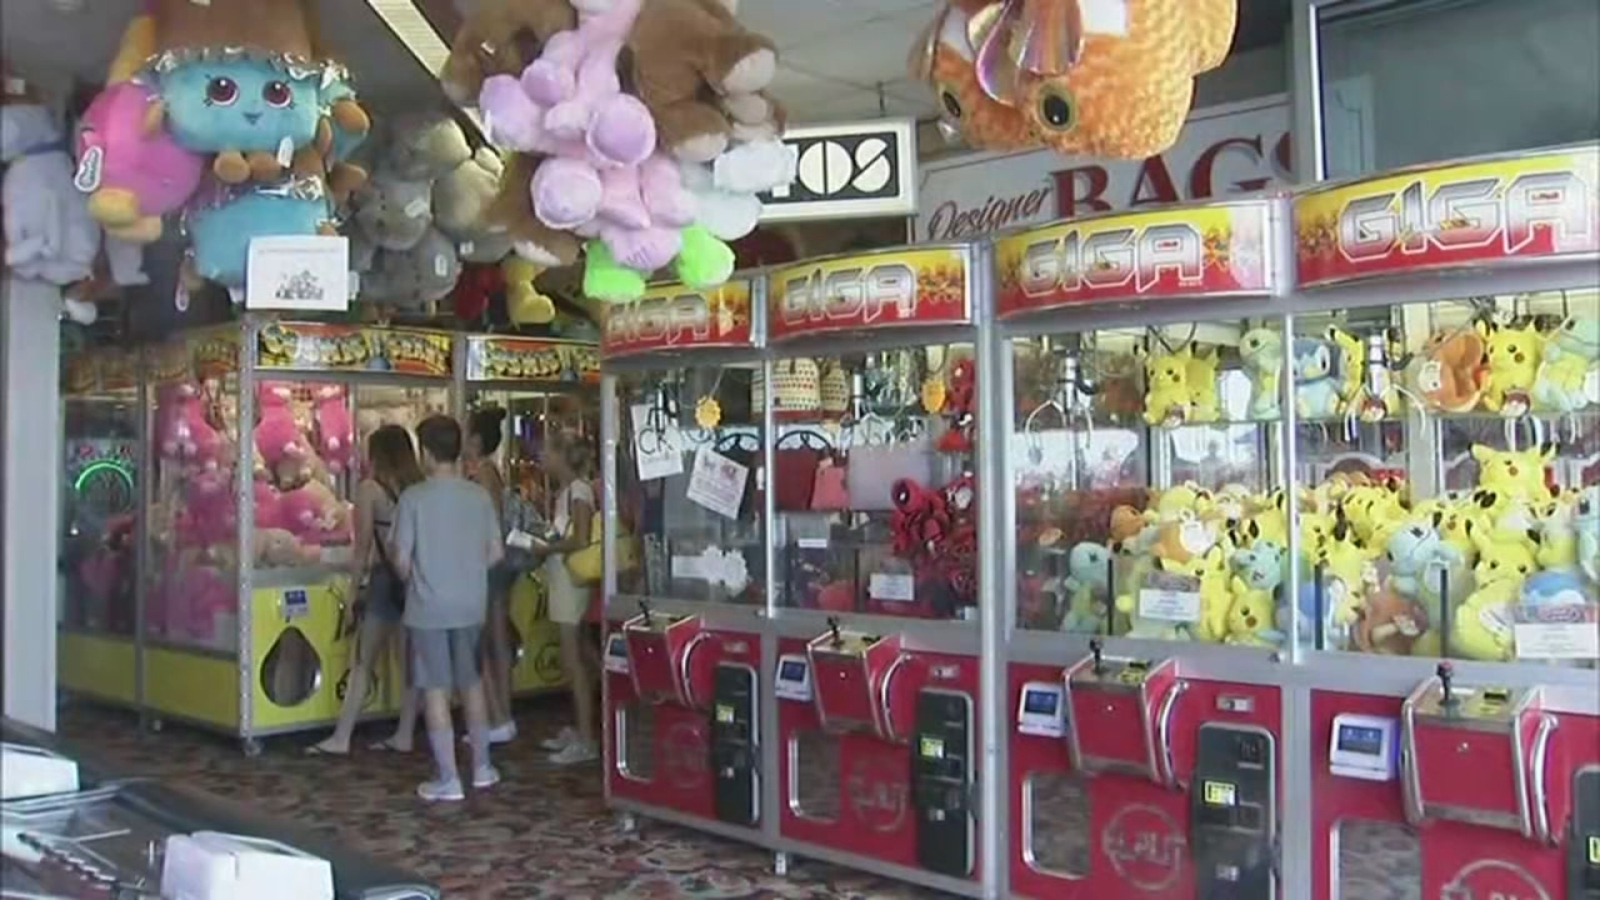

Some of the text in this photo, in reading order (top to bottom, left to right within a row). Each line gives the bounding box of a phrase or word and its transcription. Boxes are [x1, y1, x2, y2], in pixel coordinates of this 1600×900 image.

[928, 187, 1050, 241] Designer
[1337, 171, 1592, 263] GIGA
[1020, 222, 1202, 294] GIGA
[782, 264, 918, 325] GIGA
